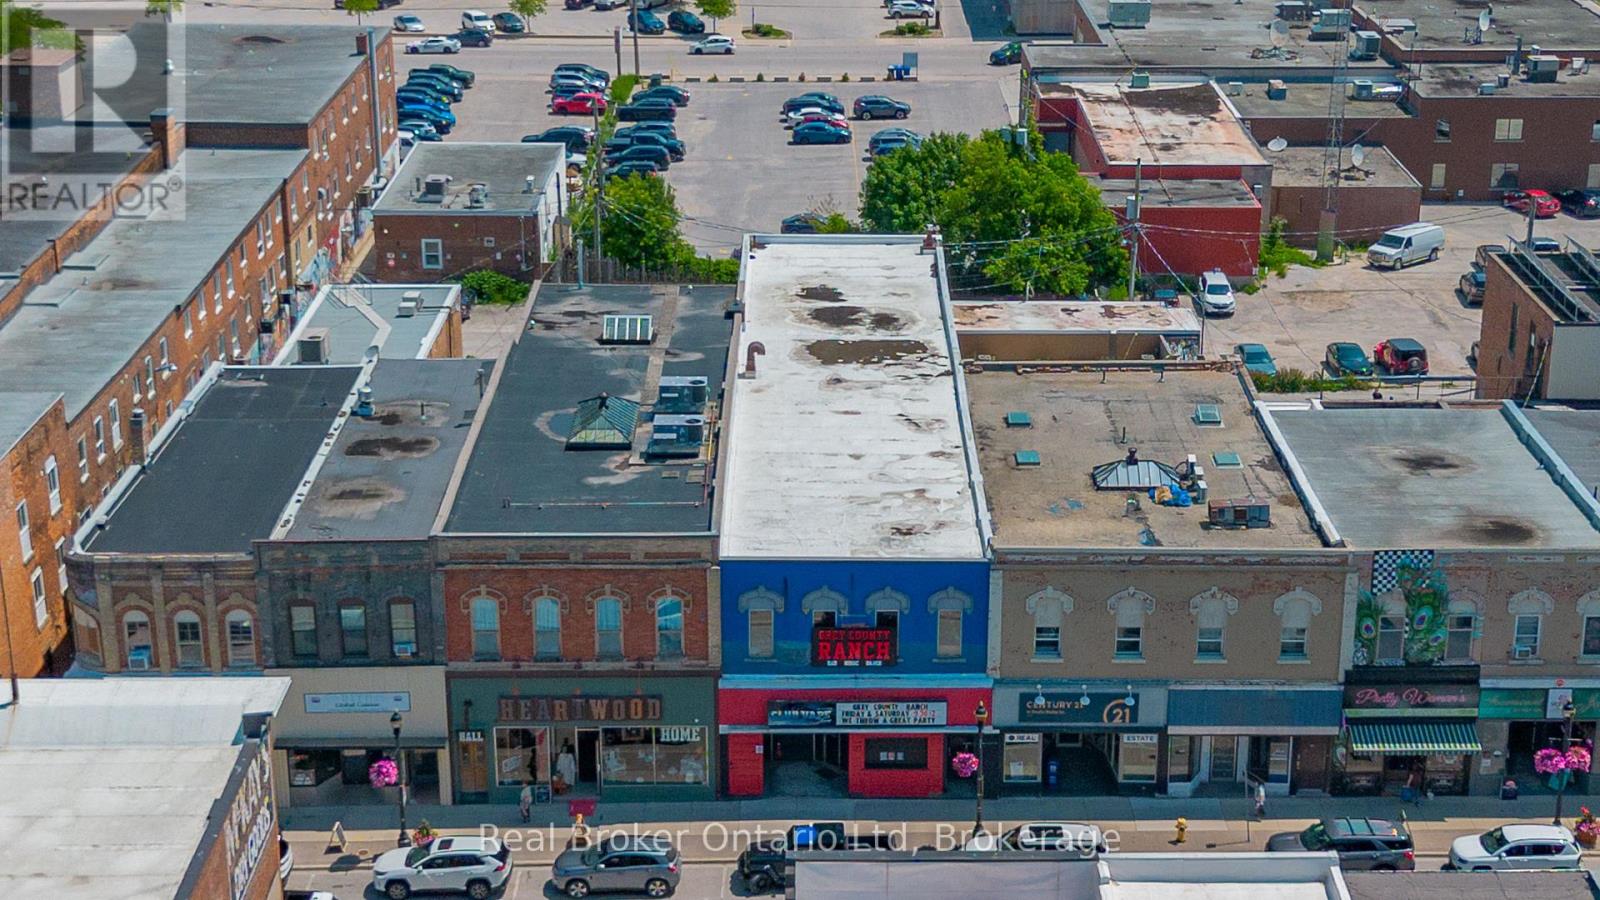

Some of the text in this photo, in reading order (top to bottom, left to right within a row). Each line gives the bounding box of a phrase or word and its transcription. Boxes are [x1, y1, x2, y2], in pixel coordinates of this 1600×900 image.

[848, 630, 891, 640] COUNTY
[818, 641, 890, 660] RANCH
[500, 699, 661, 720] HEARTWOOD
[660, 727, 700, 742] HOME
[1016, 734, 1036, 742] REAL
[1126, 734, 1154, 742] ESTATE
